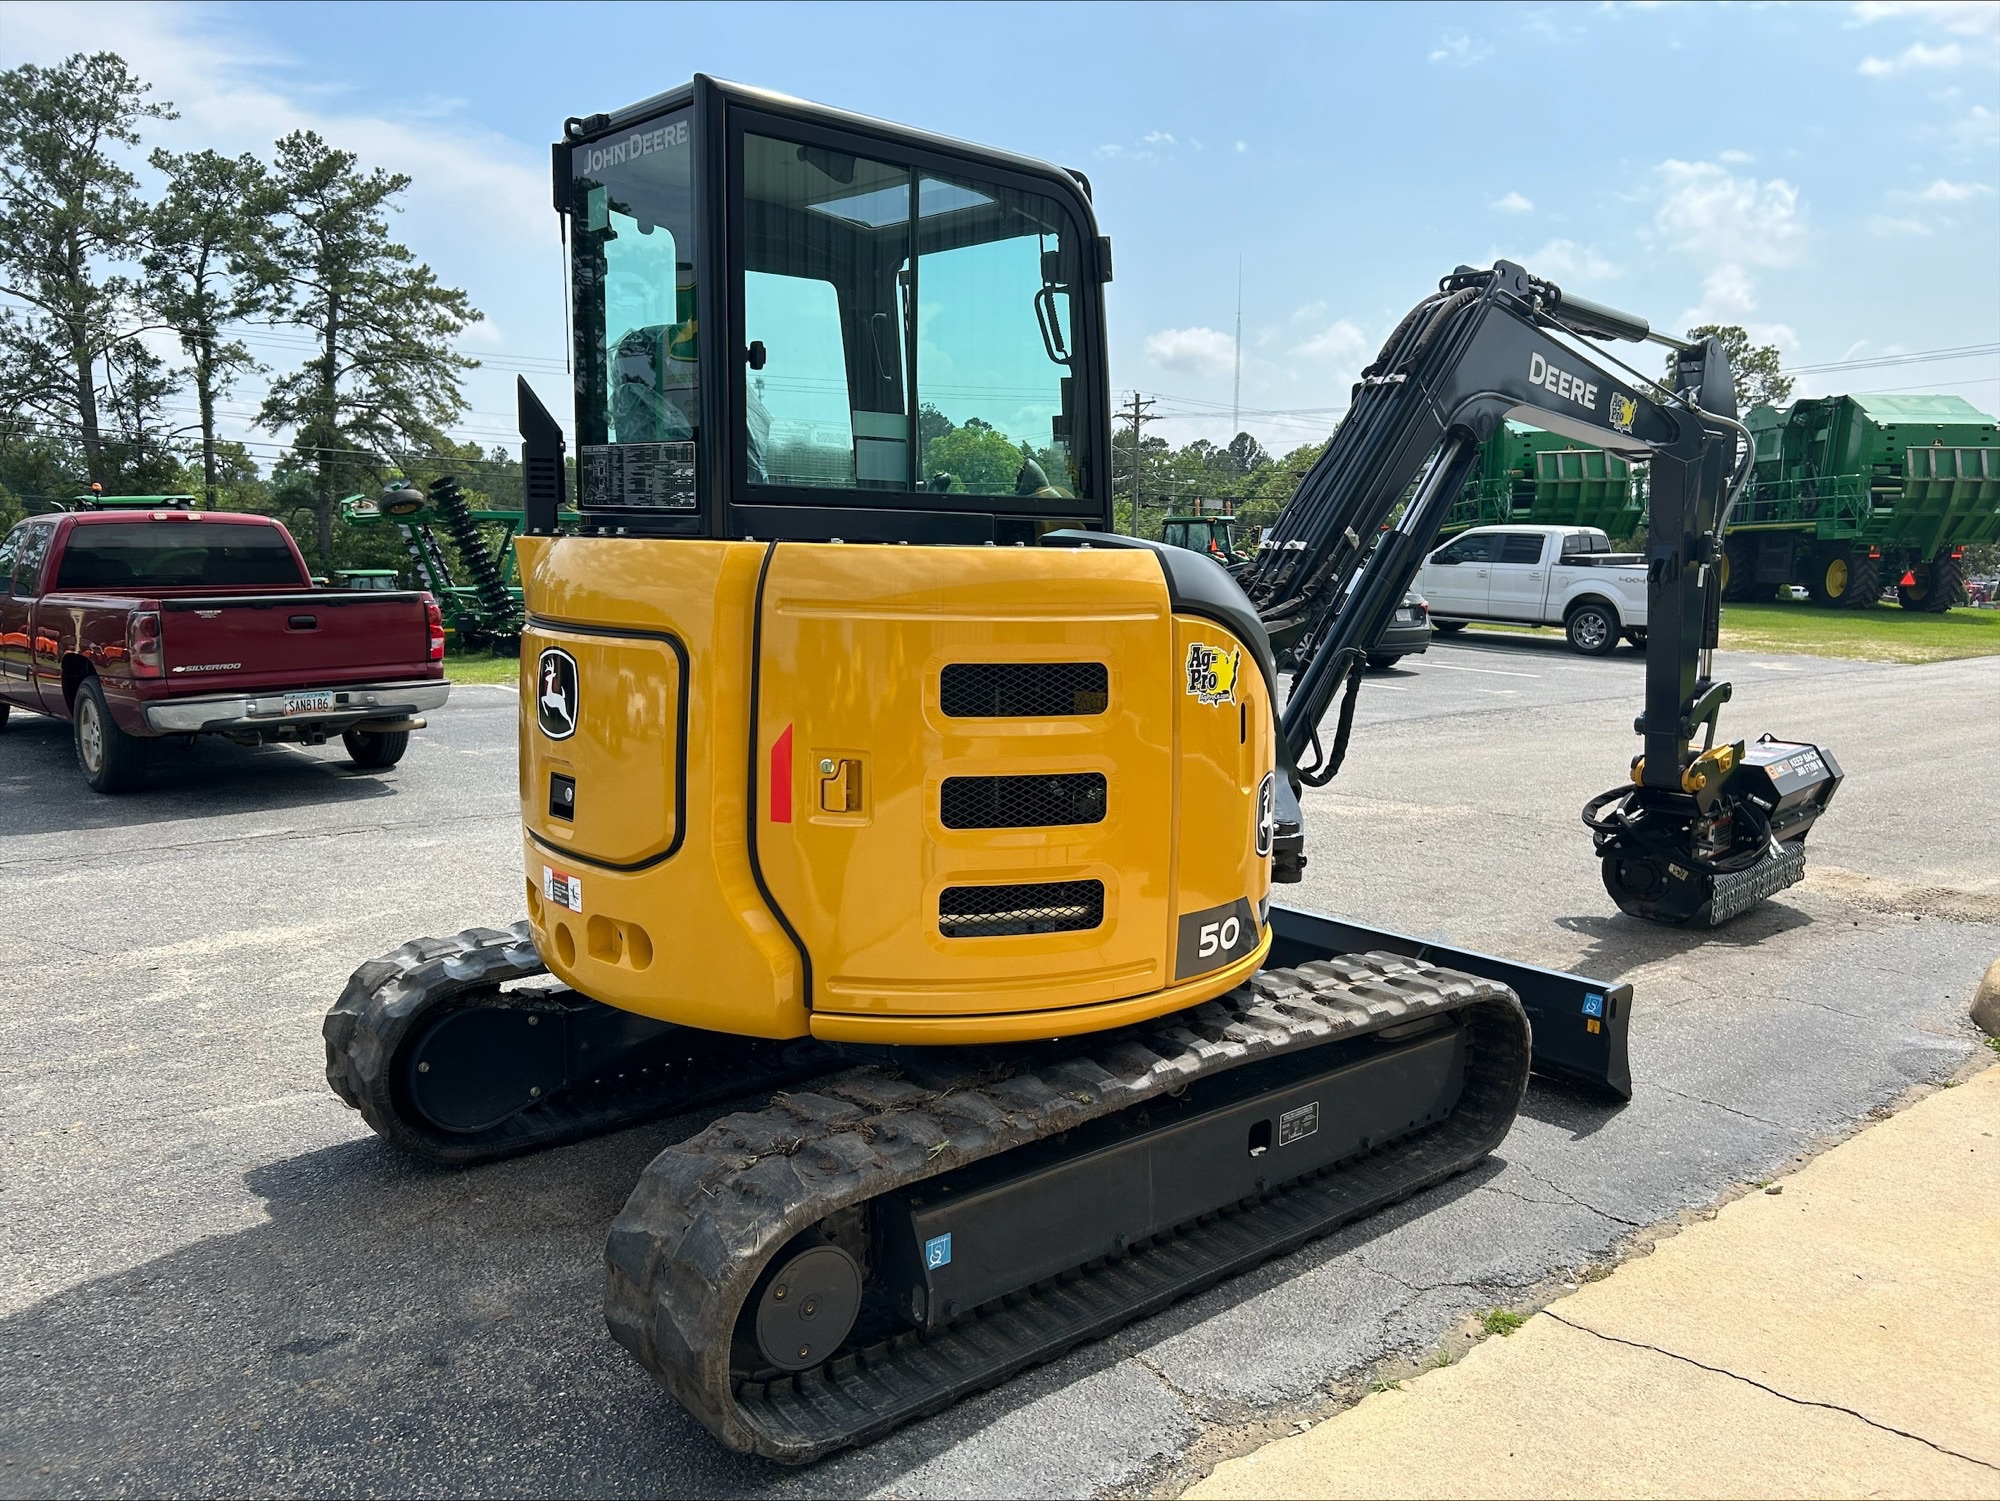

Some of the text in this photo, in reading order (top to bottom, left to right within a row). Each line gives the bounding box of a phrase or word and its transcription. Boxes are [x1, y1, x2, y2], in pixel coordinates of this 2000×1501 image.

[584, 120, 688, 175] JOHN DEERE
[1529, 351, 1598, 411] DEERE
[185, 662, 242, 673] SILVERADO
[1188, 645, 1217, 672] Ag-
[1188, 669, 1217, 691] Pro
[289, 698, 329, 712] SAN8186
[1789, 755, 1803, 768] KEEP
[1802, 750, 1819, 763] BACK
[1199, 916, 1240, 958] 50
